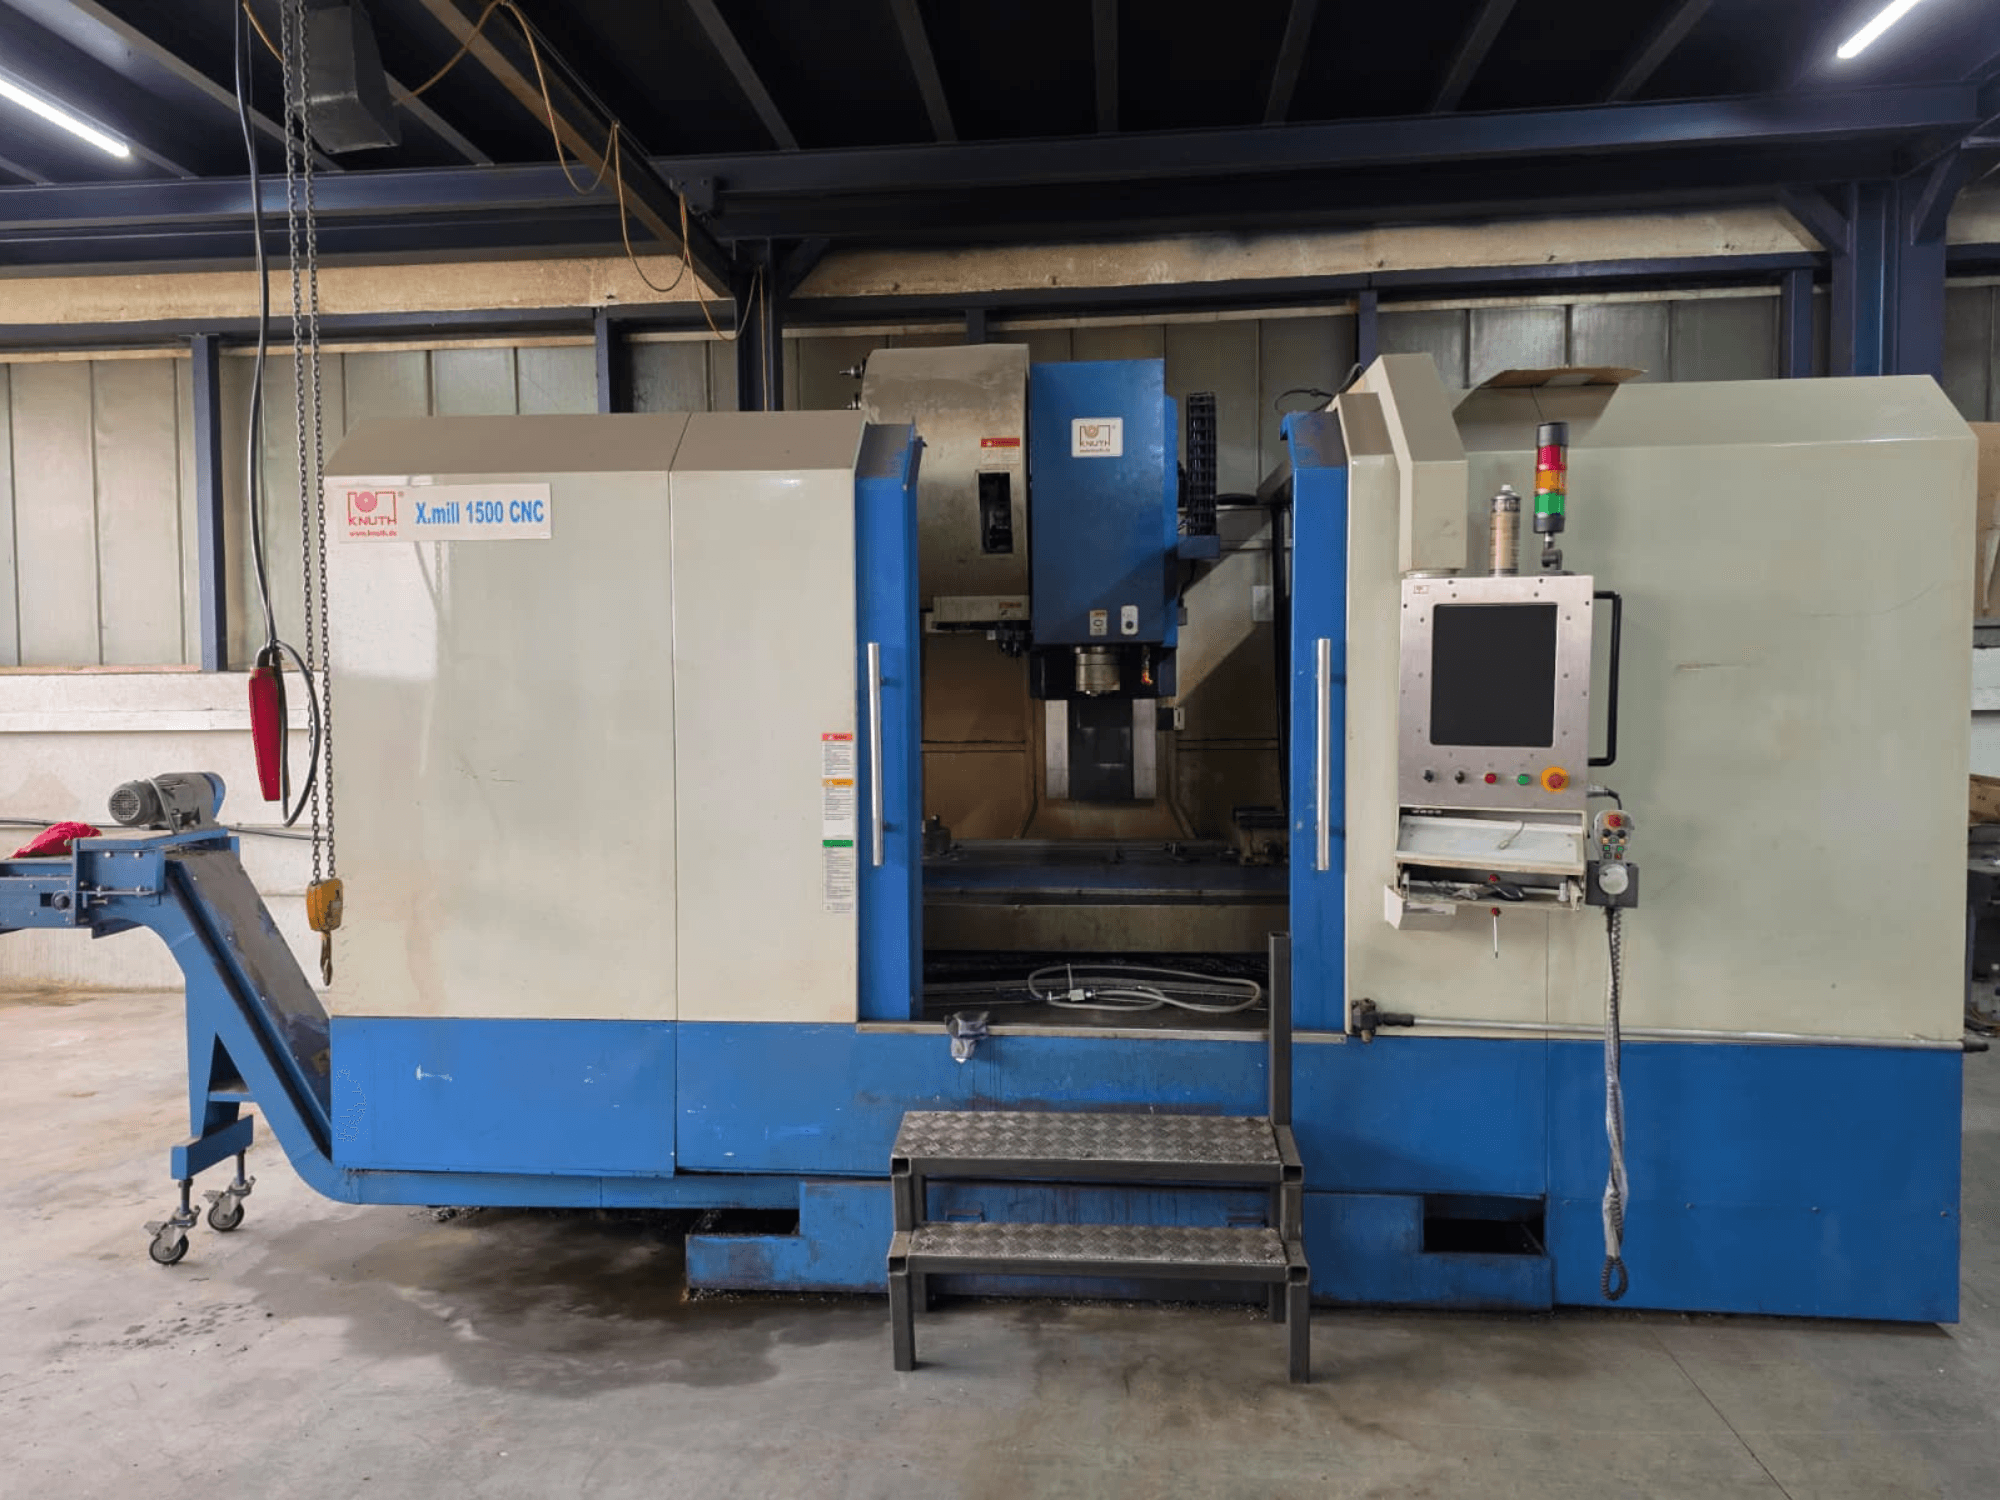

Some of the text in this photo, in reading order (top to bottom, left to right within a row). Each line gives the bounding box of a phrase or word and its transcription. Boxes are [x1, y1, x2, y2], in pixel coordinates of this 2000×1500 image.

[348, 515, 397, 526] KNUTH
[415, 500, 544, 524] X.mill 1500 CNC
